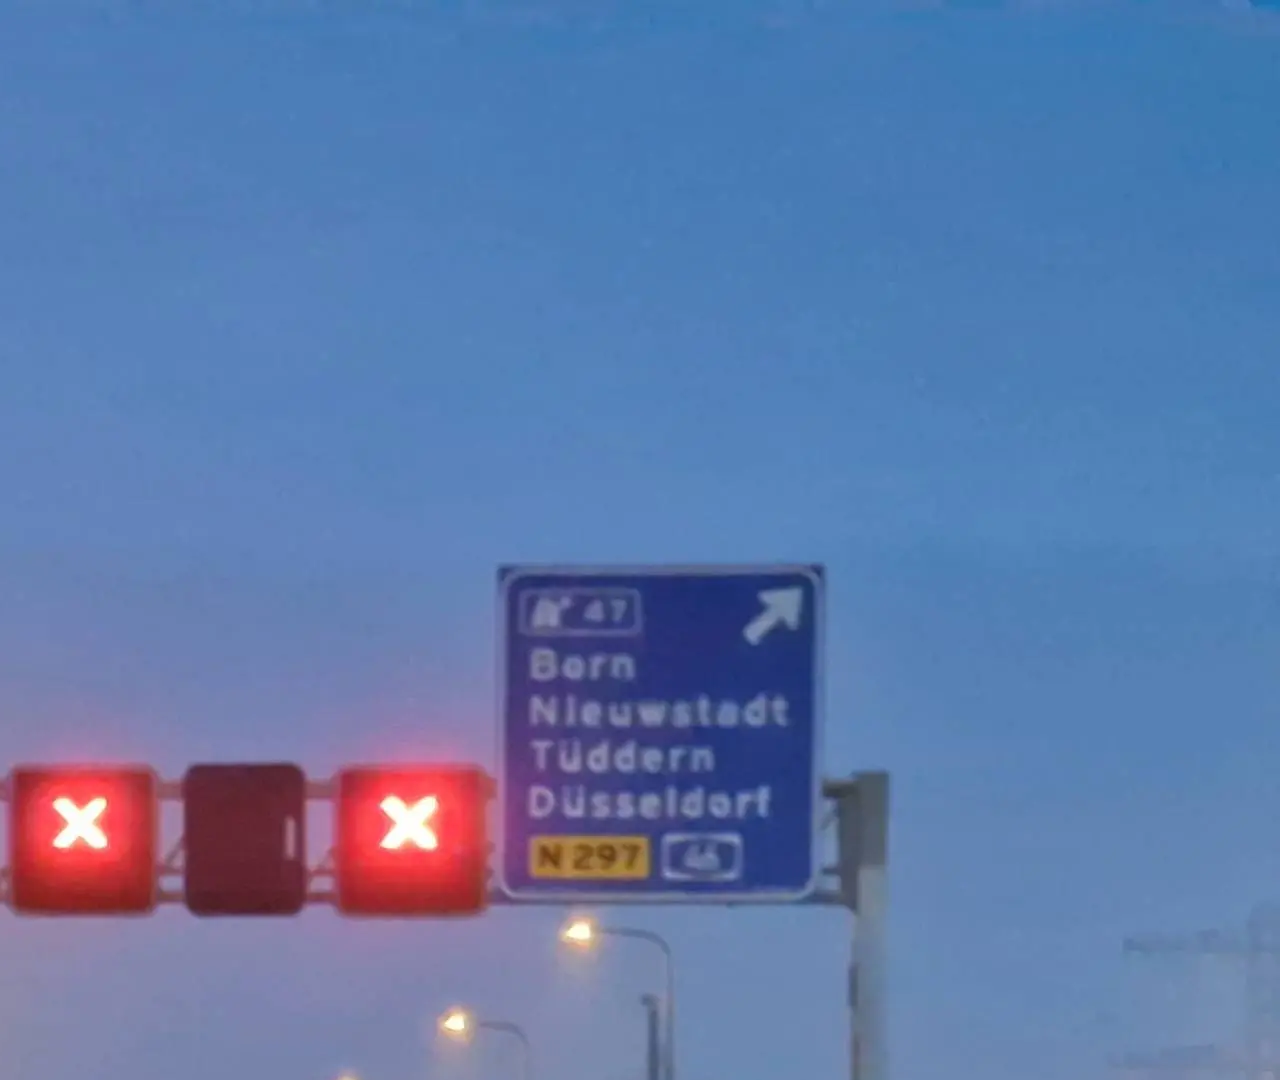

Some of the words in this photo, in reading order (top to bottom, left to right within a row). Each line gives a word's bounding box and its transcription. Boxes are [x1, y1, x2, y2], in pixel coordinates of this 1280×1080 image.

[529, 647, 636, 680] Born
[528, 692, 790, 727] Nieuwstadt
[529, 737, 715, 773] Tüddern
[528, 783, 771, 819] Düsseldorf
[539, 843, 562, 870] N
[572, 843, 642, 871] 297
